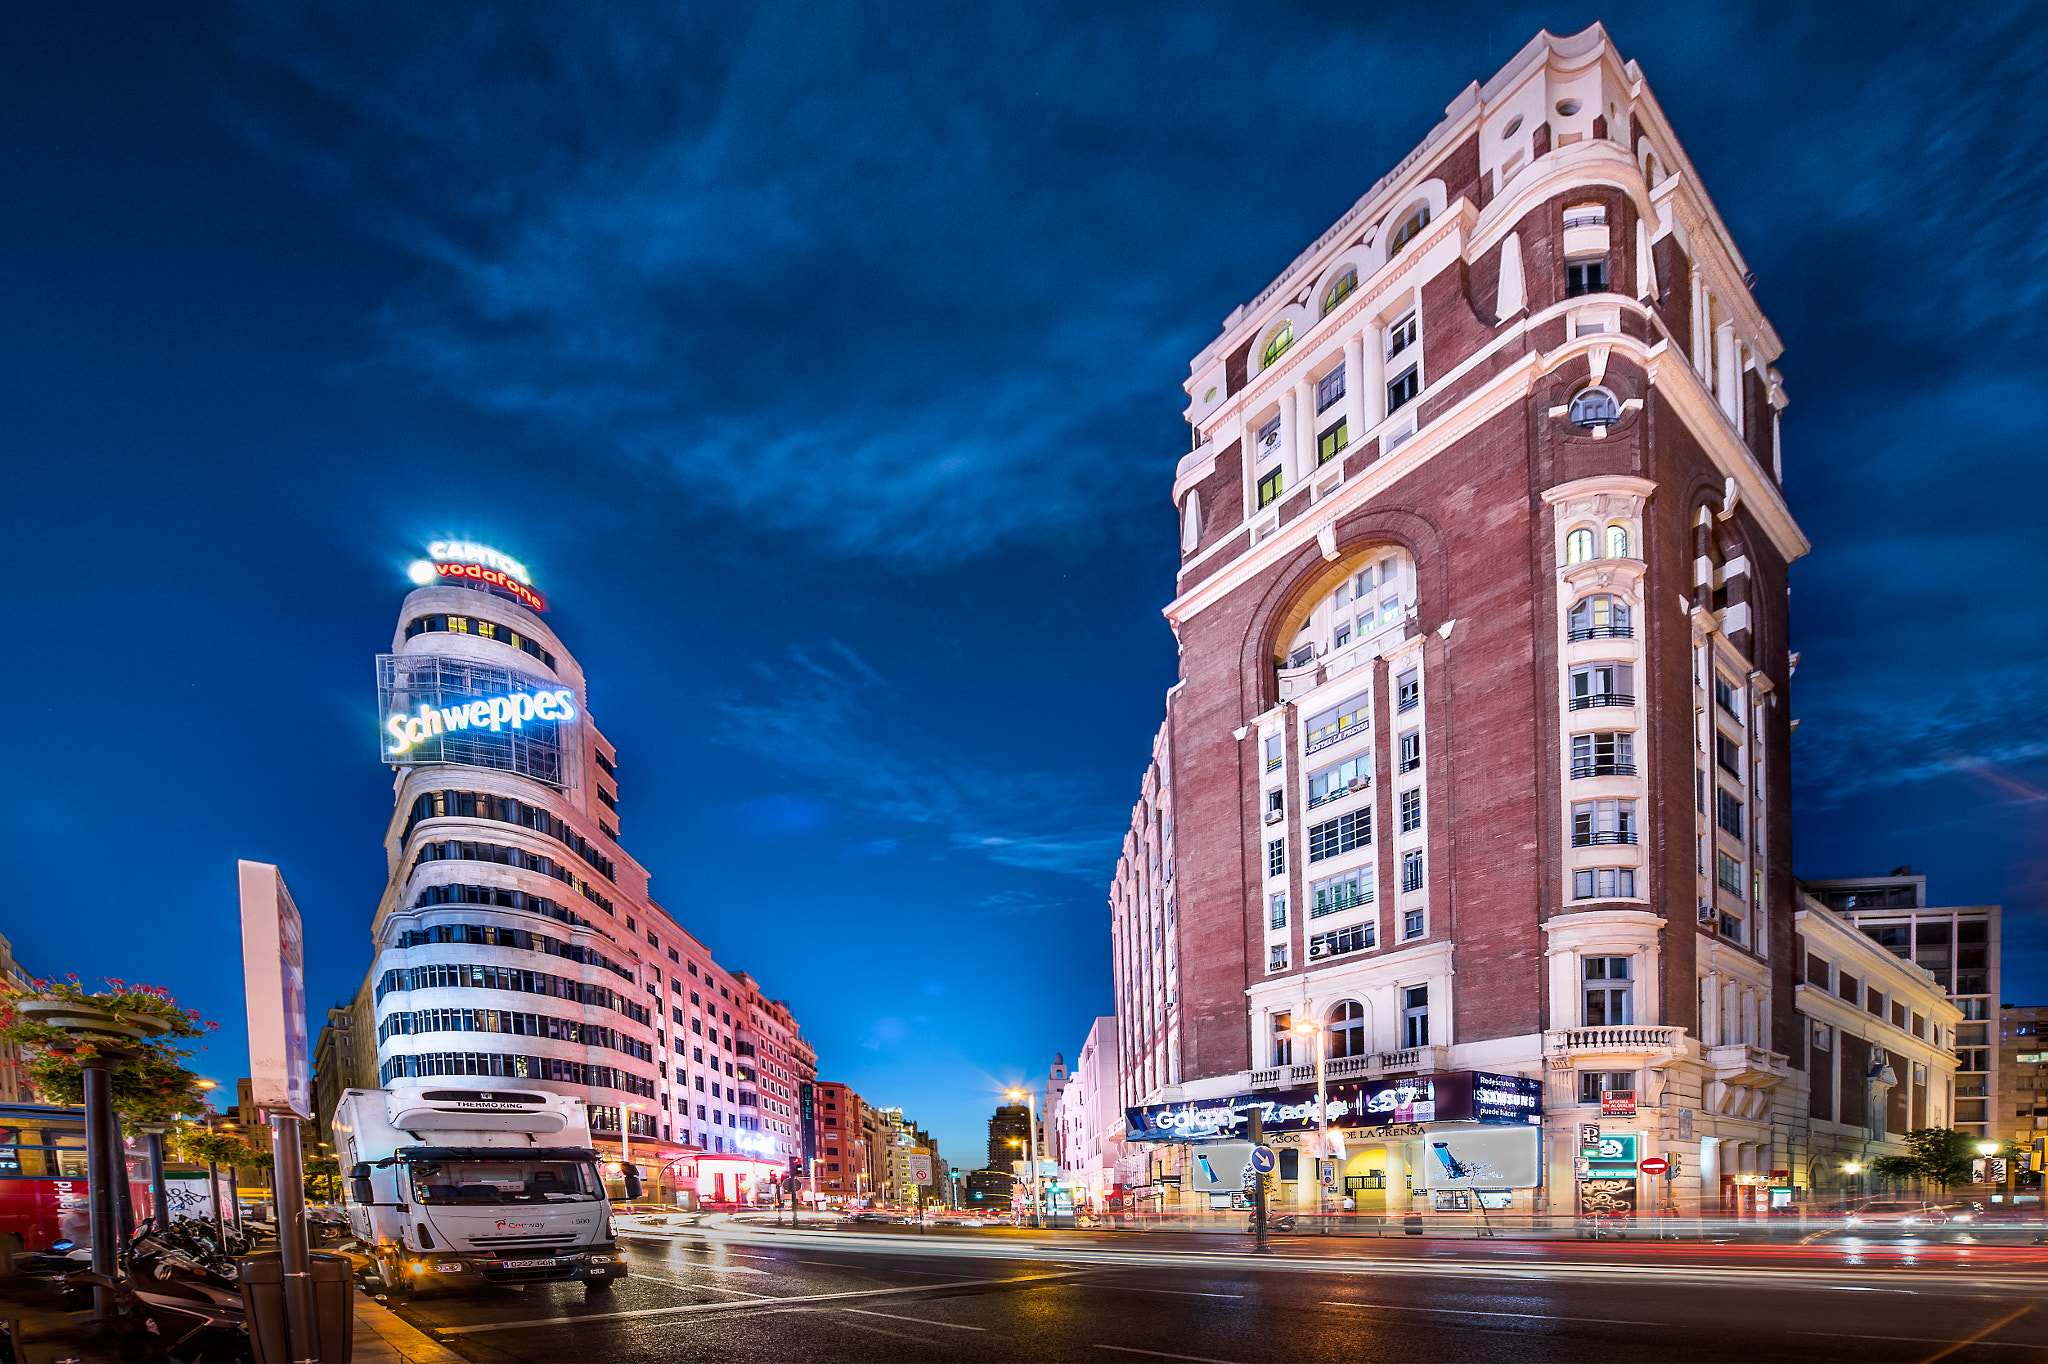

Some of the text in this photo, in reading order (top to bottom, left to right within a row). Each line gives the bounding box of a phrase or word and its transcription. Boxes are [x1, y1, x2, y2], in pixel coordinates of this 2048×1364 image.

[434, 562, 544, 612] vodafone
[388, 689, 575, 755] Schweppes
[1333, 733, 1342, 743] LA
[1480, 1076, 1516, 1088] Redescubre
[803, 1086, 812, 1120] HOTEL
[1482, 1090, 1536, 1108] SAMSUNG
[1156, 1106, 1238, 1129] Galaxy
[1272, 1134, 1300, 1144] ASOC
[1360, 1130, 1375, 1139] LA
[1378, 1127, 1426, 1138] PRENSA
[54, 1181, 73, 1219] Madrid
[510, 1260, 534, 1268] 0222
